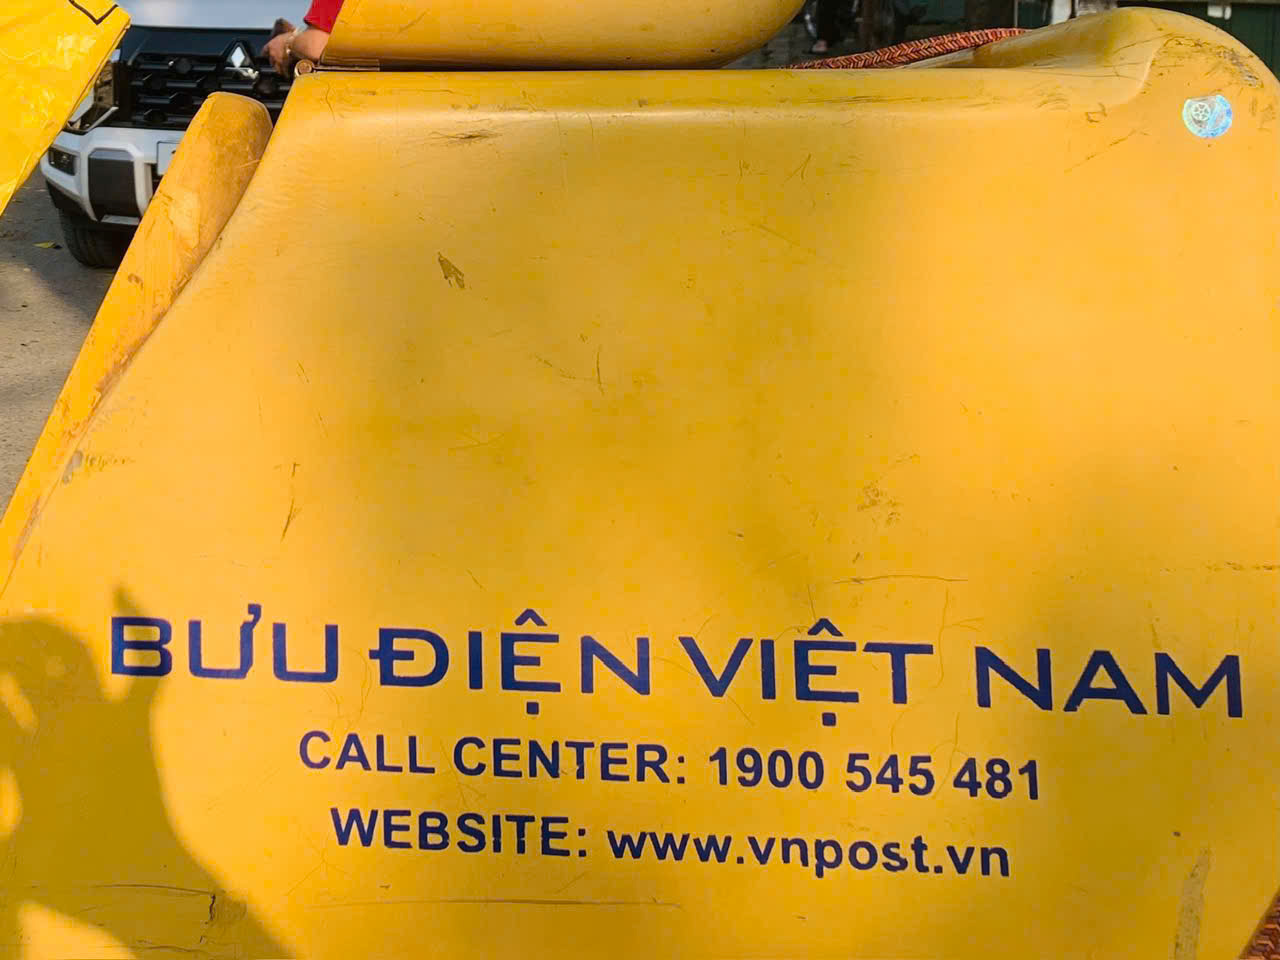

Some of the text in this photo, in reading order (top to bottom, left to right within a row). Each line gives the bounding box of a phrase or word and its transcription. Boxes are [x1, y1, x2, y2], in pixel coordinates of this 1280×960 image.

[110, 603, 1244, 728] BƯU ĐIỆN VIỆT NAM
[299, 730, 1040, 802] CALL CENTER: 1900 545 481
[330, 807, 1010, 879] WEBSITE: www.vnpost.vn
